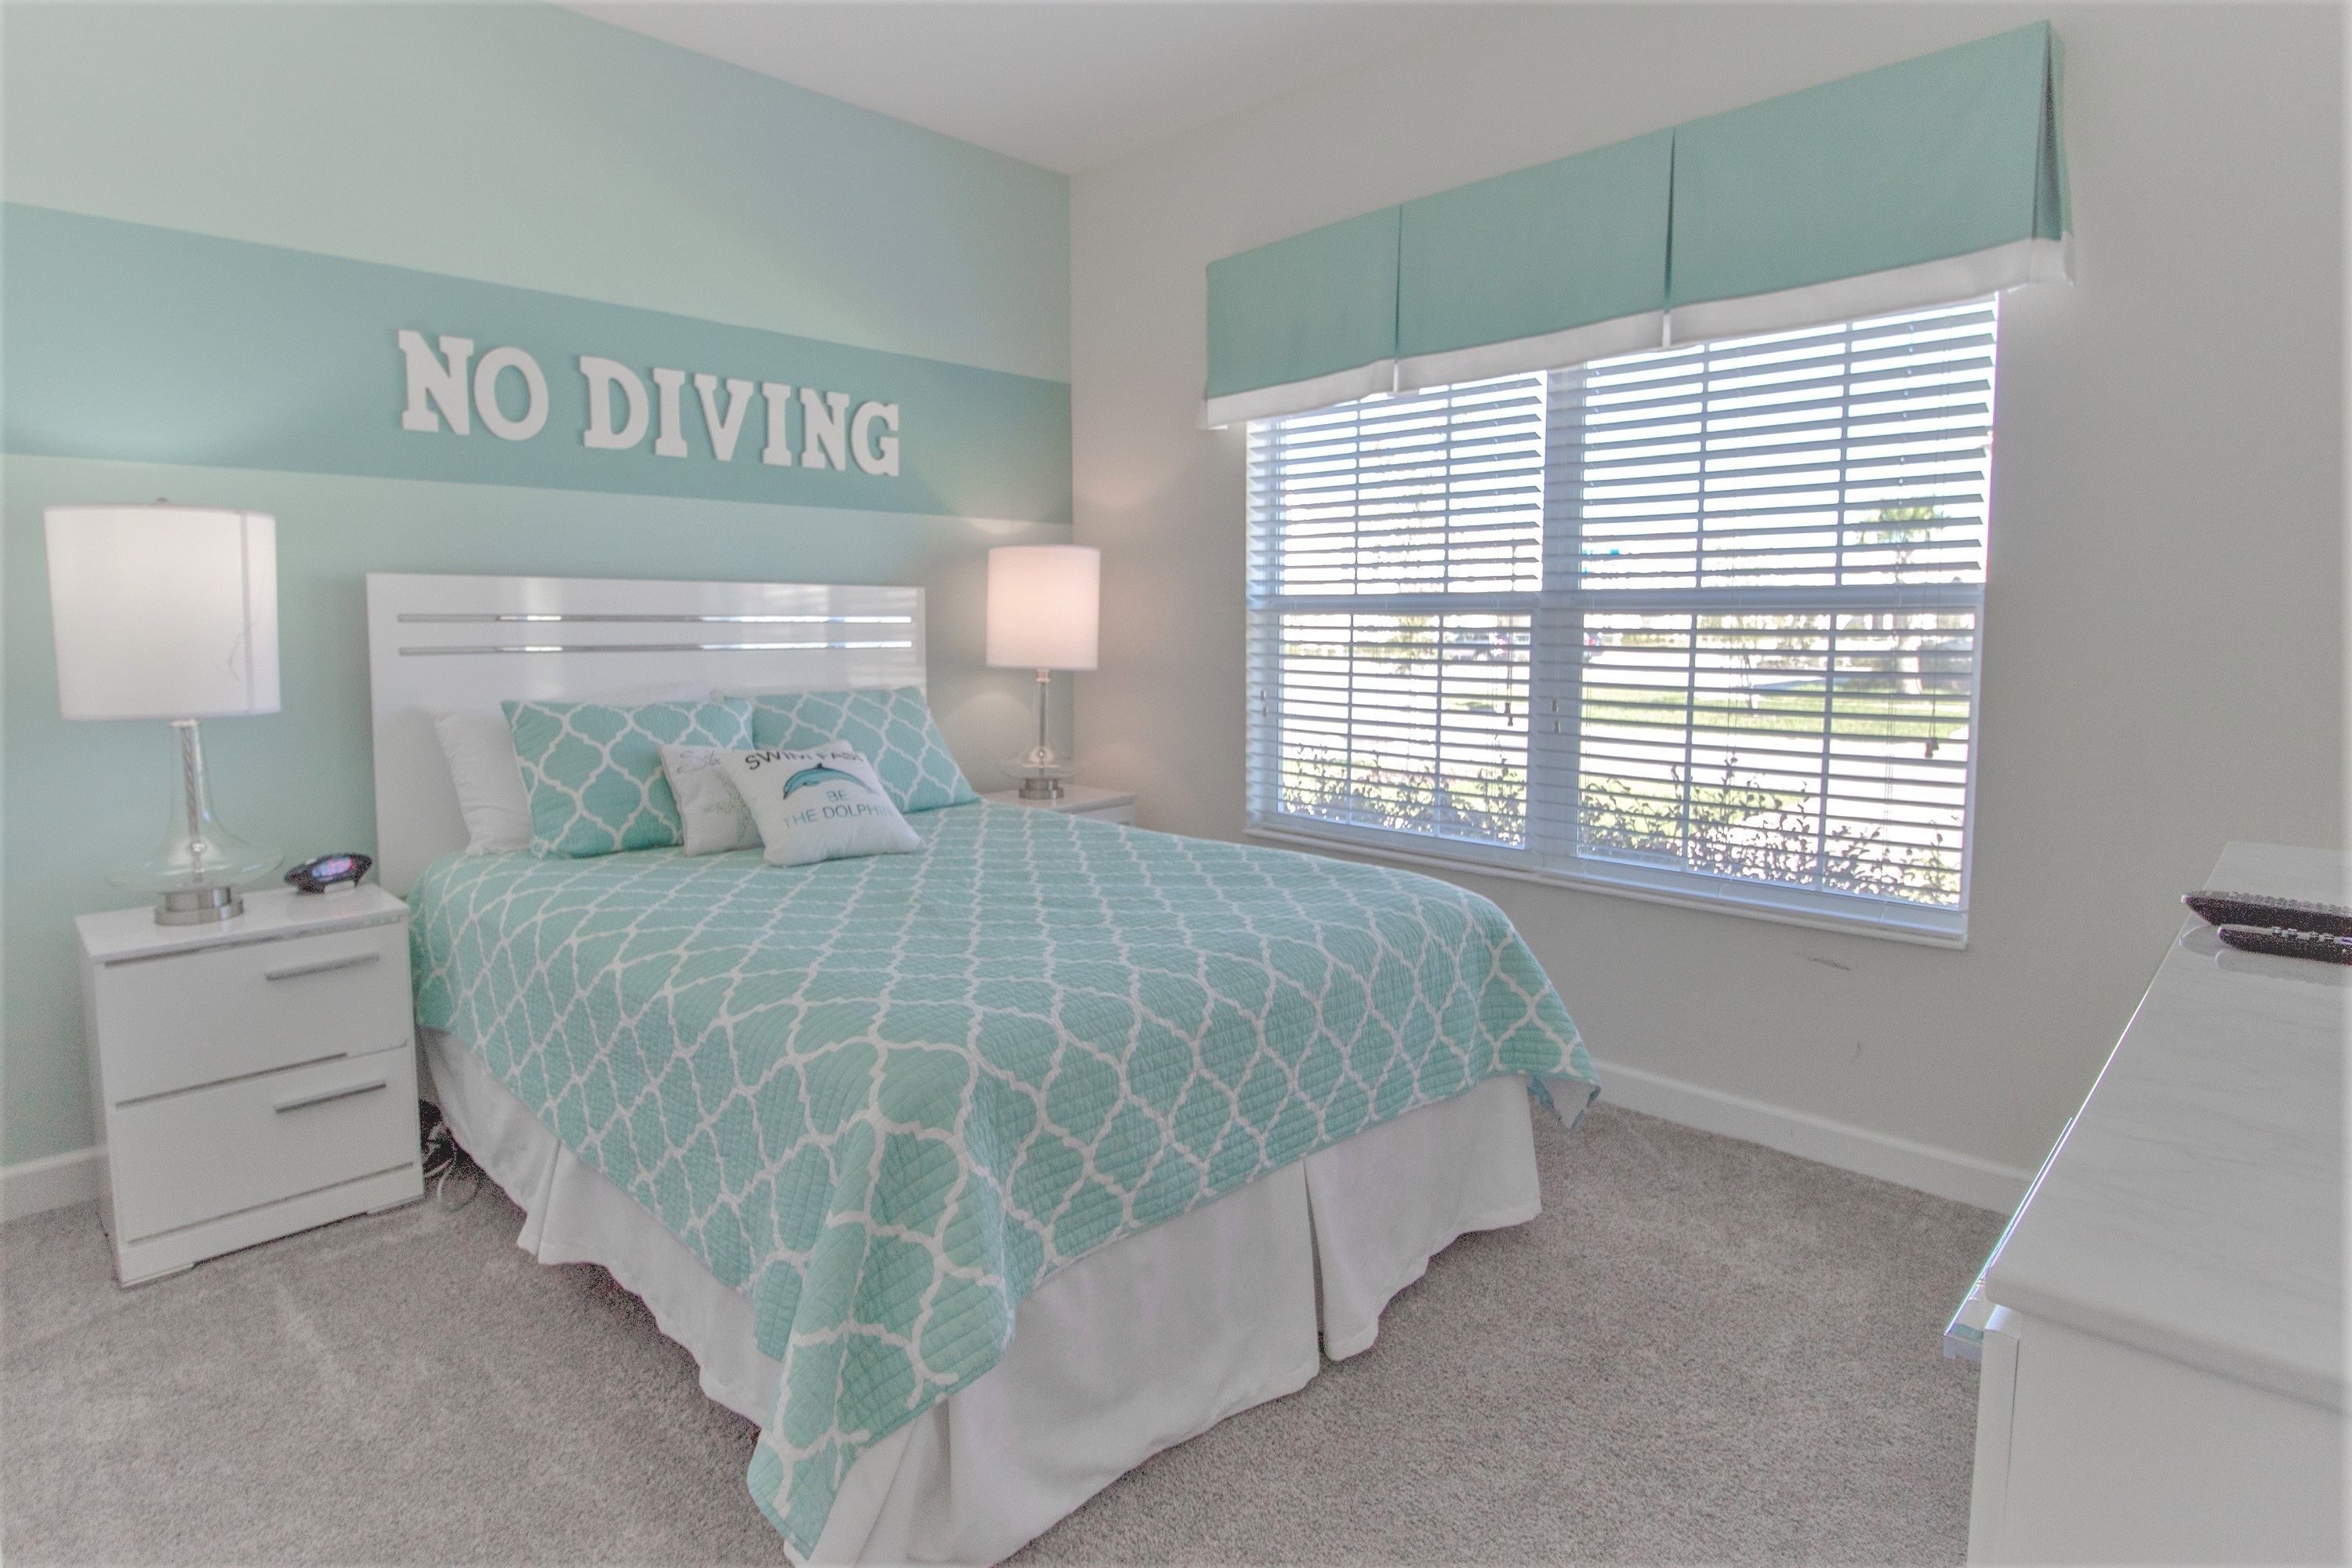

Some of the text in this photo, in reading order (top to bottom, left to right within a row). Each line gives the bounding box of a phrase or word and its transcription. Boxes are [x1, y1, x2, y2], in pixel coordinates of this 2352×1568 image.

[398, 329, 899, 477] NO DIVING
[826, 789, 848, 802] BE
[782, 808, 818, 828] THE
